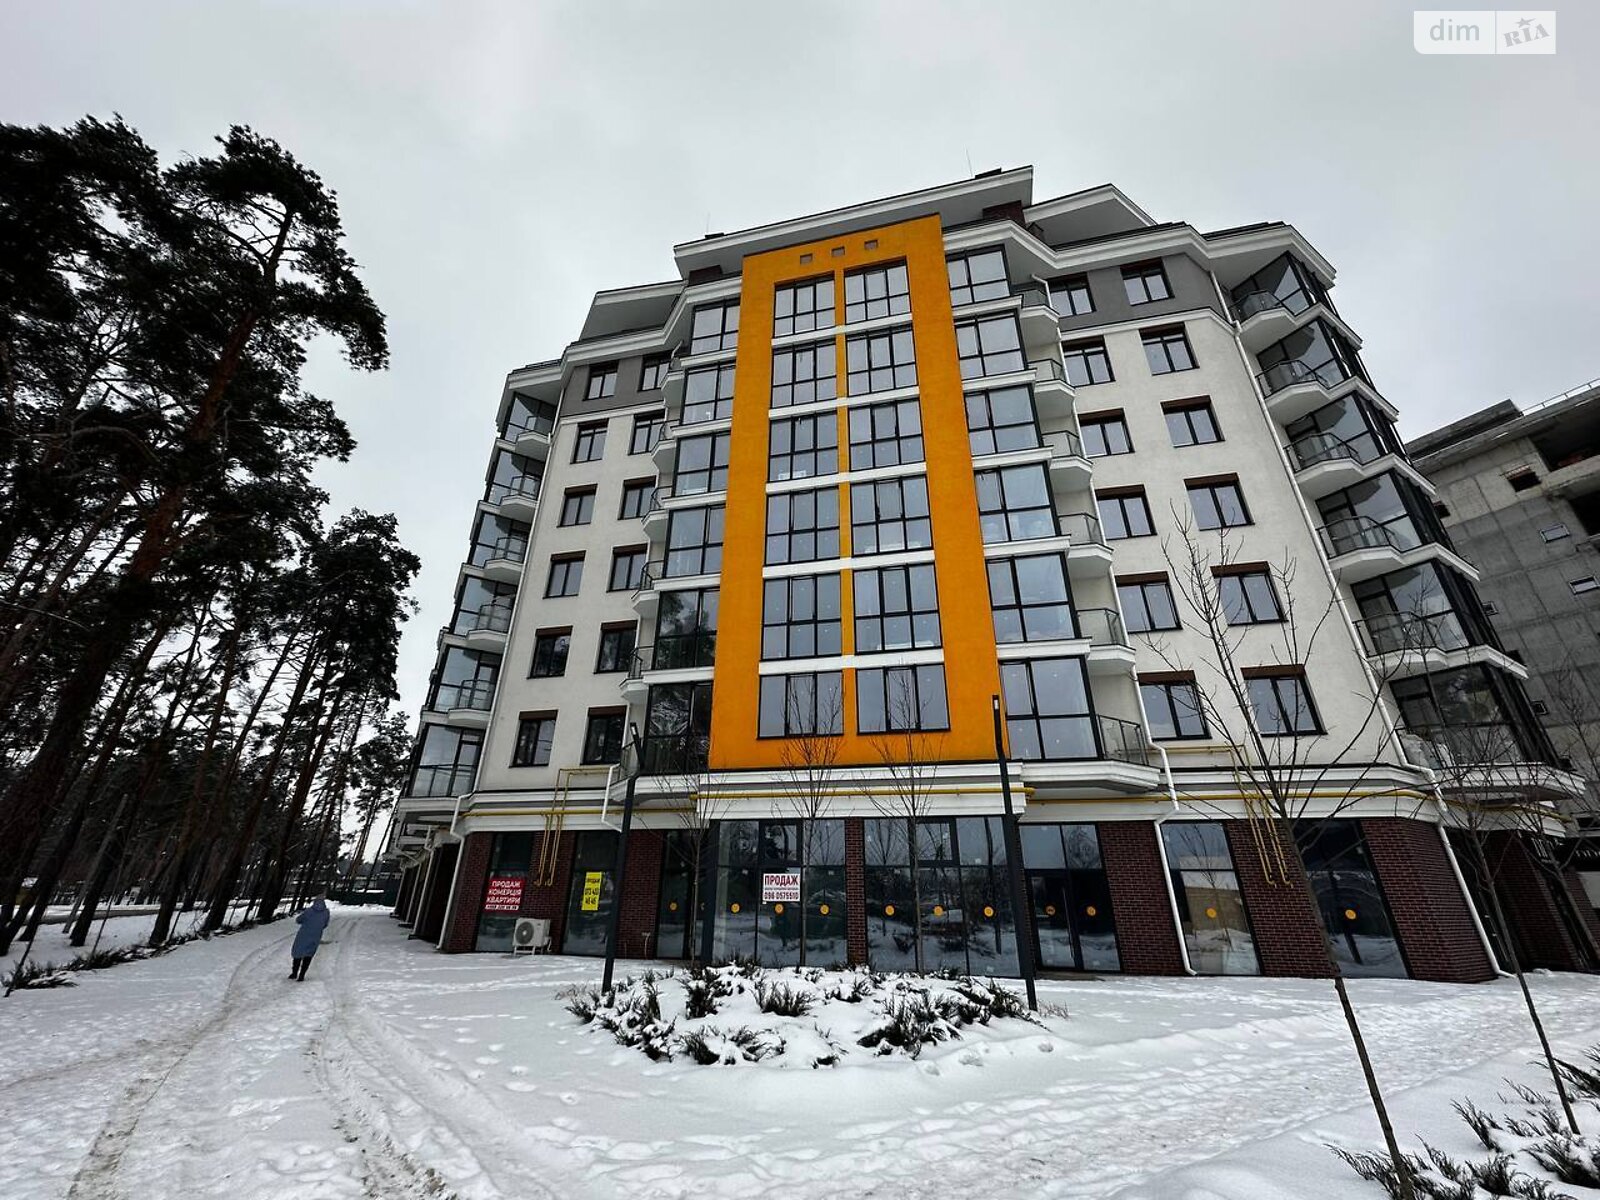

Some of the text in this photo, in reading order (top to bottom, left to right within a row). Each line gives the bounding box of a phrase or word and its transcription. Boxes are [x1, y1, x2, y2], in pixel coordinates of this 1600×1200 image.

[491, 880, 521, 888] ПРОДАЖ
[764, 875, 799, 886] ПРОДАЖ
[486, 896, 521, 904] КВАРТИРИ
